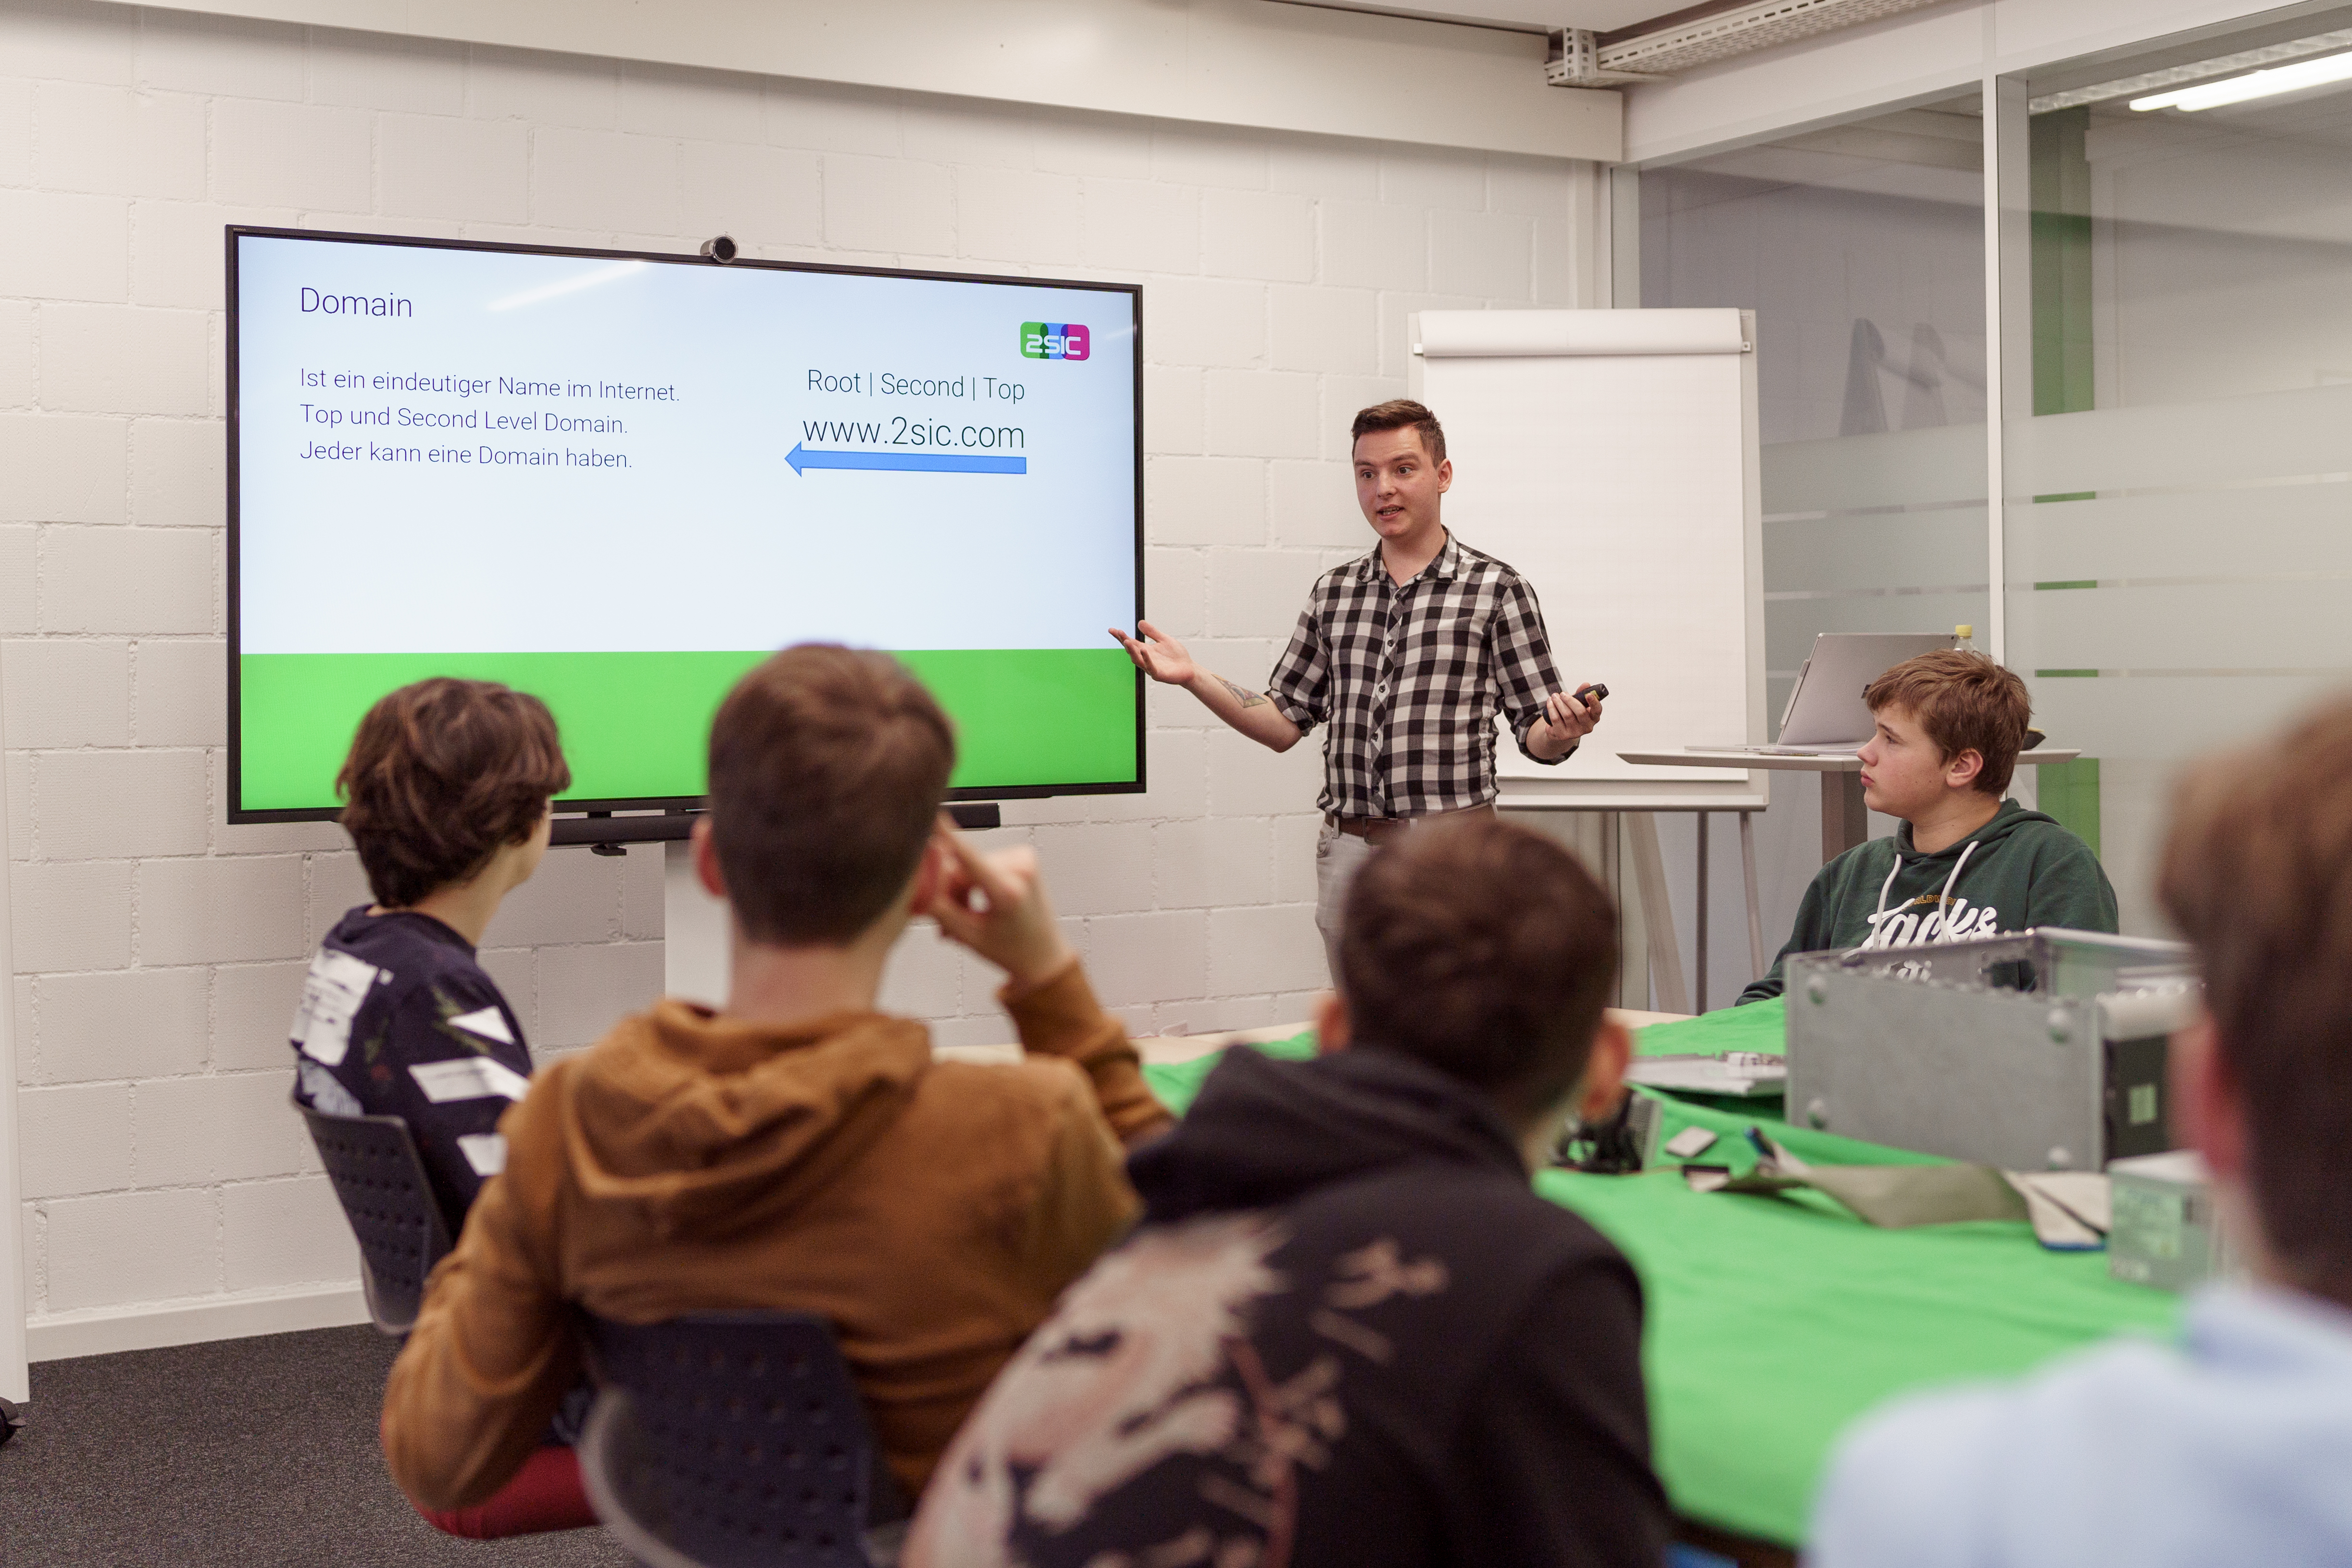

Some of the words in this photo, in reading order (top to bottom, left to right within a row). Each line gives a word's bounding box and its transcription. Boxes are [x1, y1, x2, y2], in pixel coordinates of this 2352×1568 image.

[302, 288, 411, 318] Domain
[302, 368, 326, 387] Ist
[335, 370, 364, 389] ein
[373, 372, 491, 398] eindeutiger
[500, 376, 560, 397] Name
[568, 379, 591, 398] im
[601, 381, 679, 401] Internet.
[809, 369, 861, 393] Root
[881, 373, 963, 398] Second
[983, 377, 1025, 404] Top
[300, 404, 342, 429] Top
[351, 406, 389, 426] und
[398, 408, 476, 428] Second
[486, 411, 537, 430] Level
[546, 413, 627, 433] Domain.
[803, 416, 1025, 448] www.2sic.com
[300, 441, 362, 461] Jeder
[371, 441, 420, 462] kann
[429, 445, 471, 464] eine
[480, 446, 558, 466] Domain
[567, 448, 632, 468] haben.
